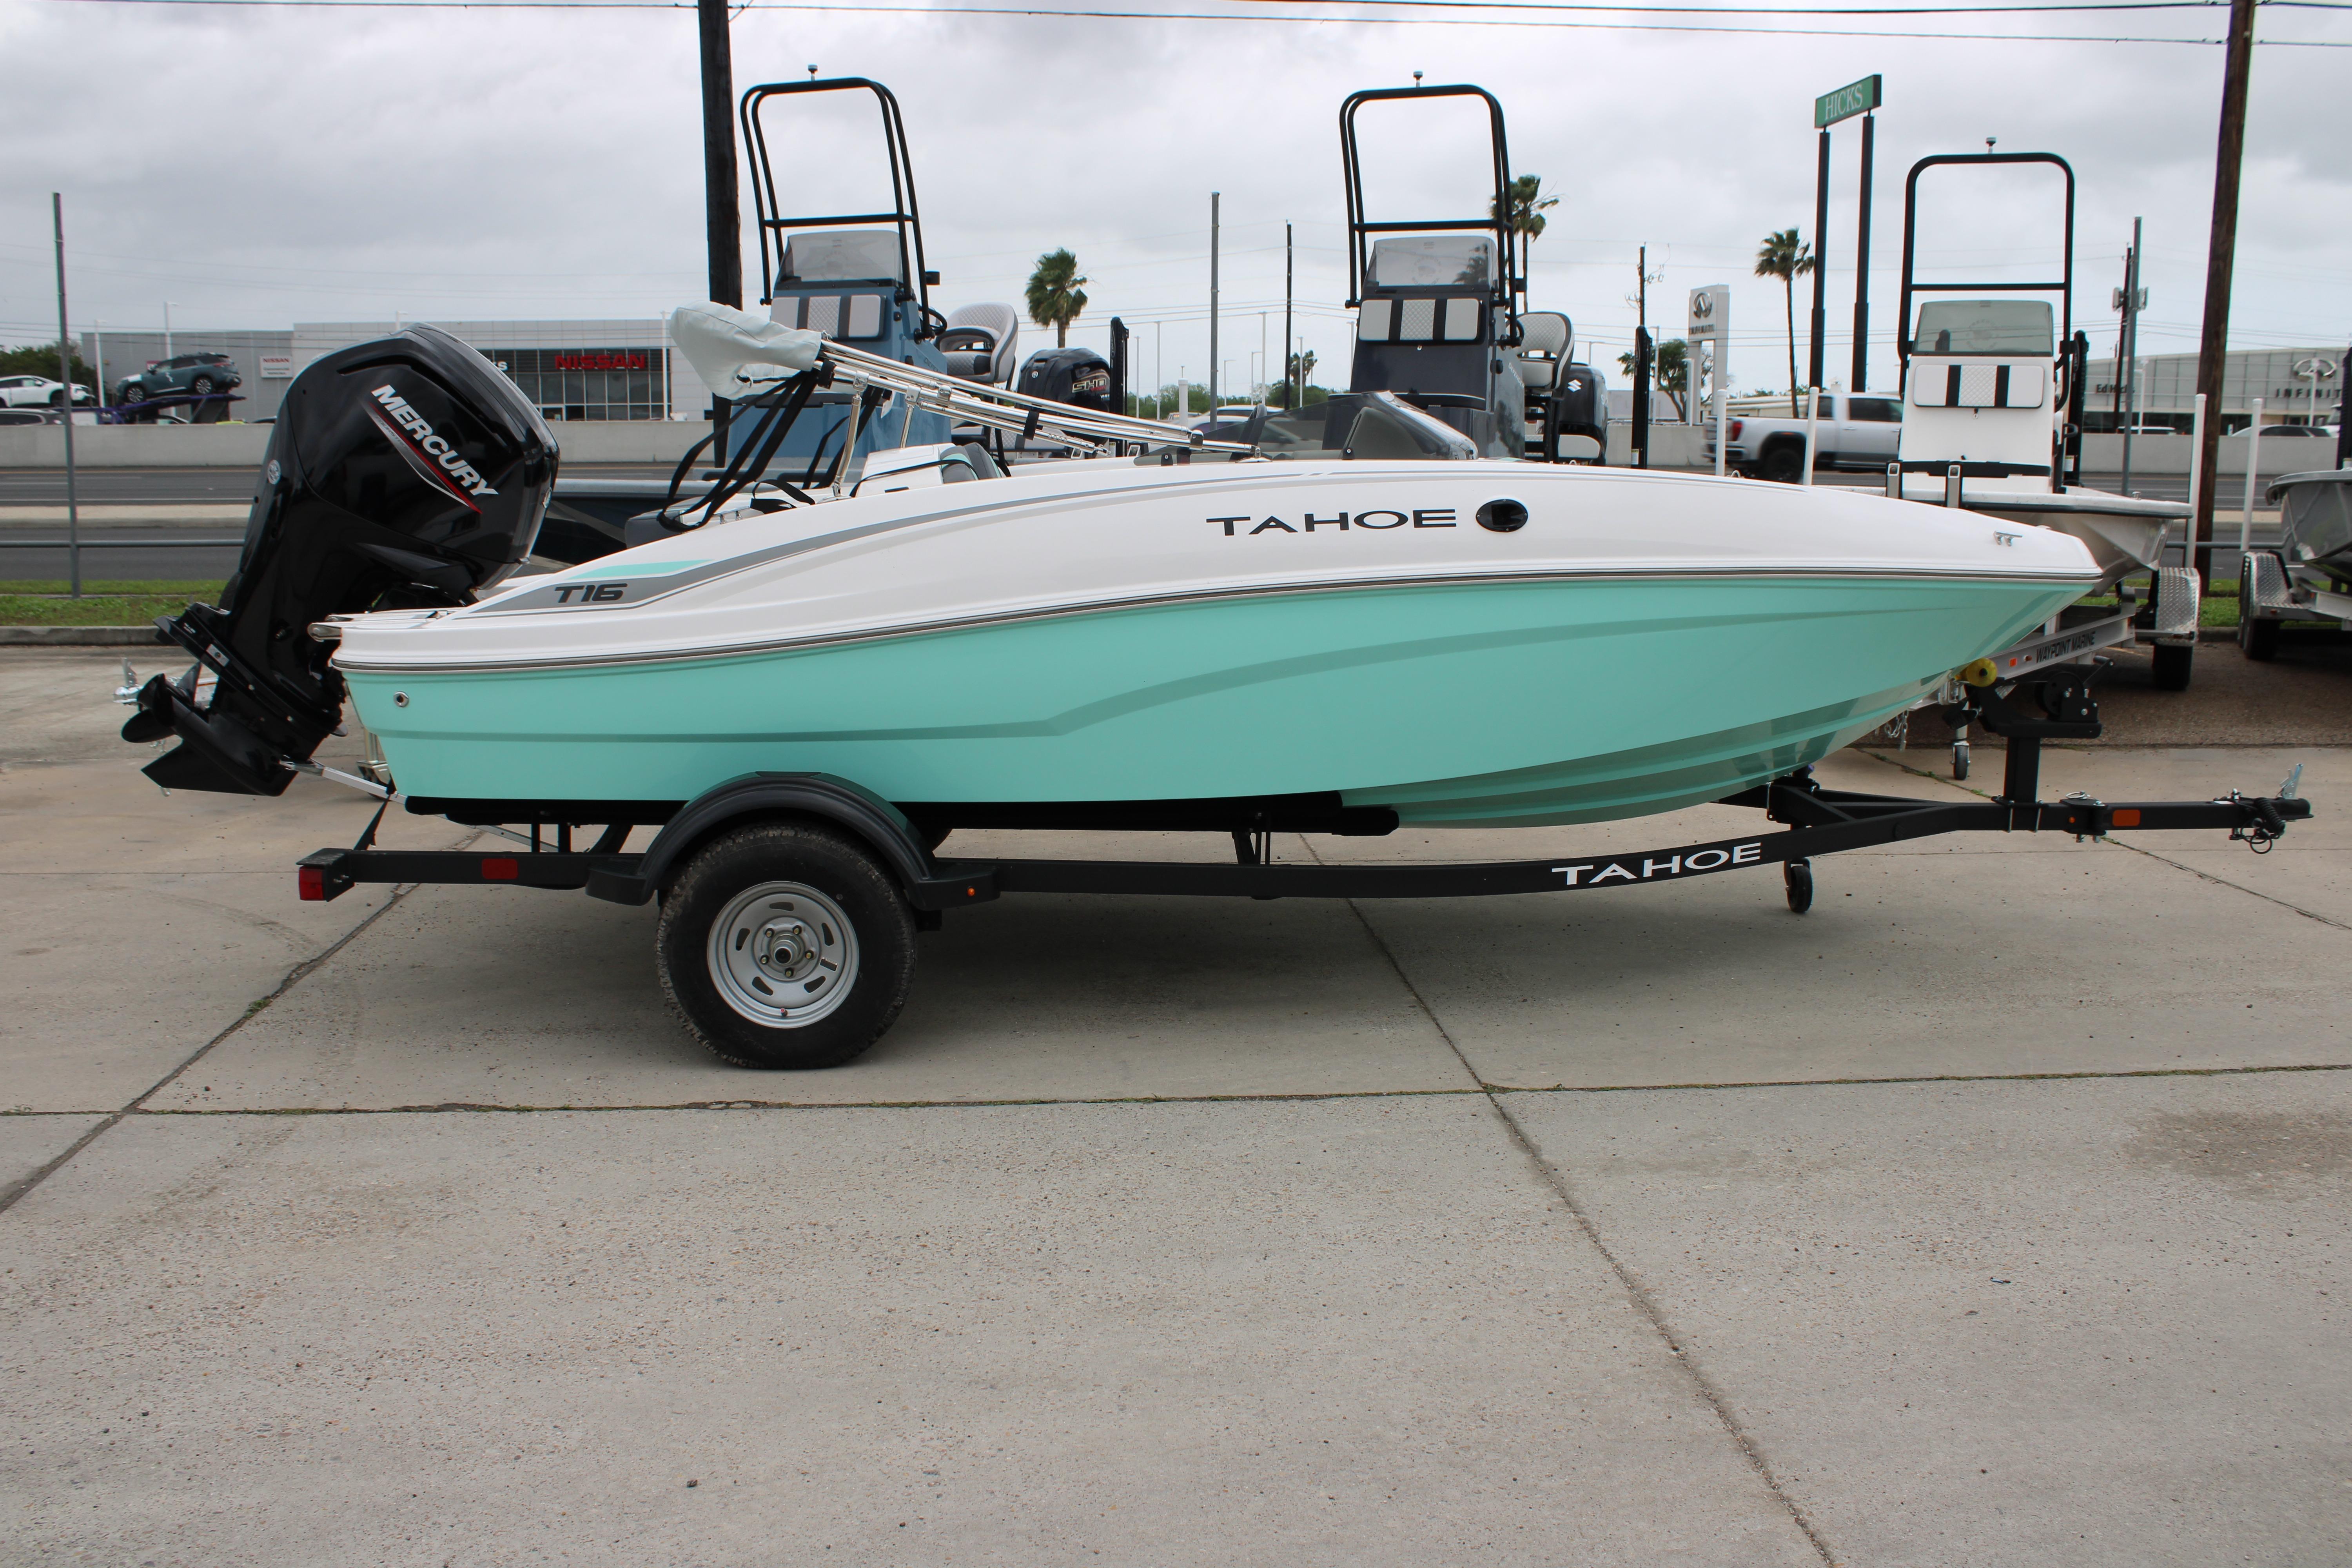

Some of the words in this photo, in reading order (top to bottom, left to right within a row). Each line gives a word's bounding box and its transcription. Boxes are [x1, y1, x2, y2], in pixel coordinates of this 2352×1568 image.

[1825, 84, 1863, 120] HICKS
[555, 354, 646, 369] NISSAN
[1072, 378, 1107, 393] SHO
[2095, 384, 2108, 393] Ed
[2276, 388, 2343, 398] INFINIT
[371, 384, 499, 495] MERCURY
[1206, 509, 1456, 536] TAHOE
[554, 583, 628, 603] T16
[2036, 639, 2071, 663] WAYPOINT
[2071, 631, 2096, 652] MARINE
[1551, 842, 1761, 885] TAHOE
